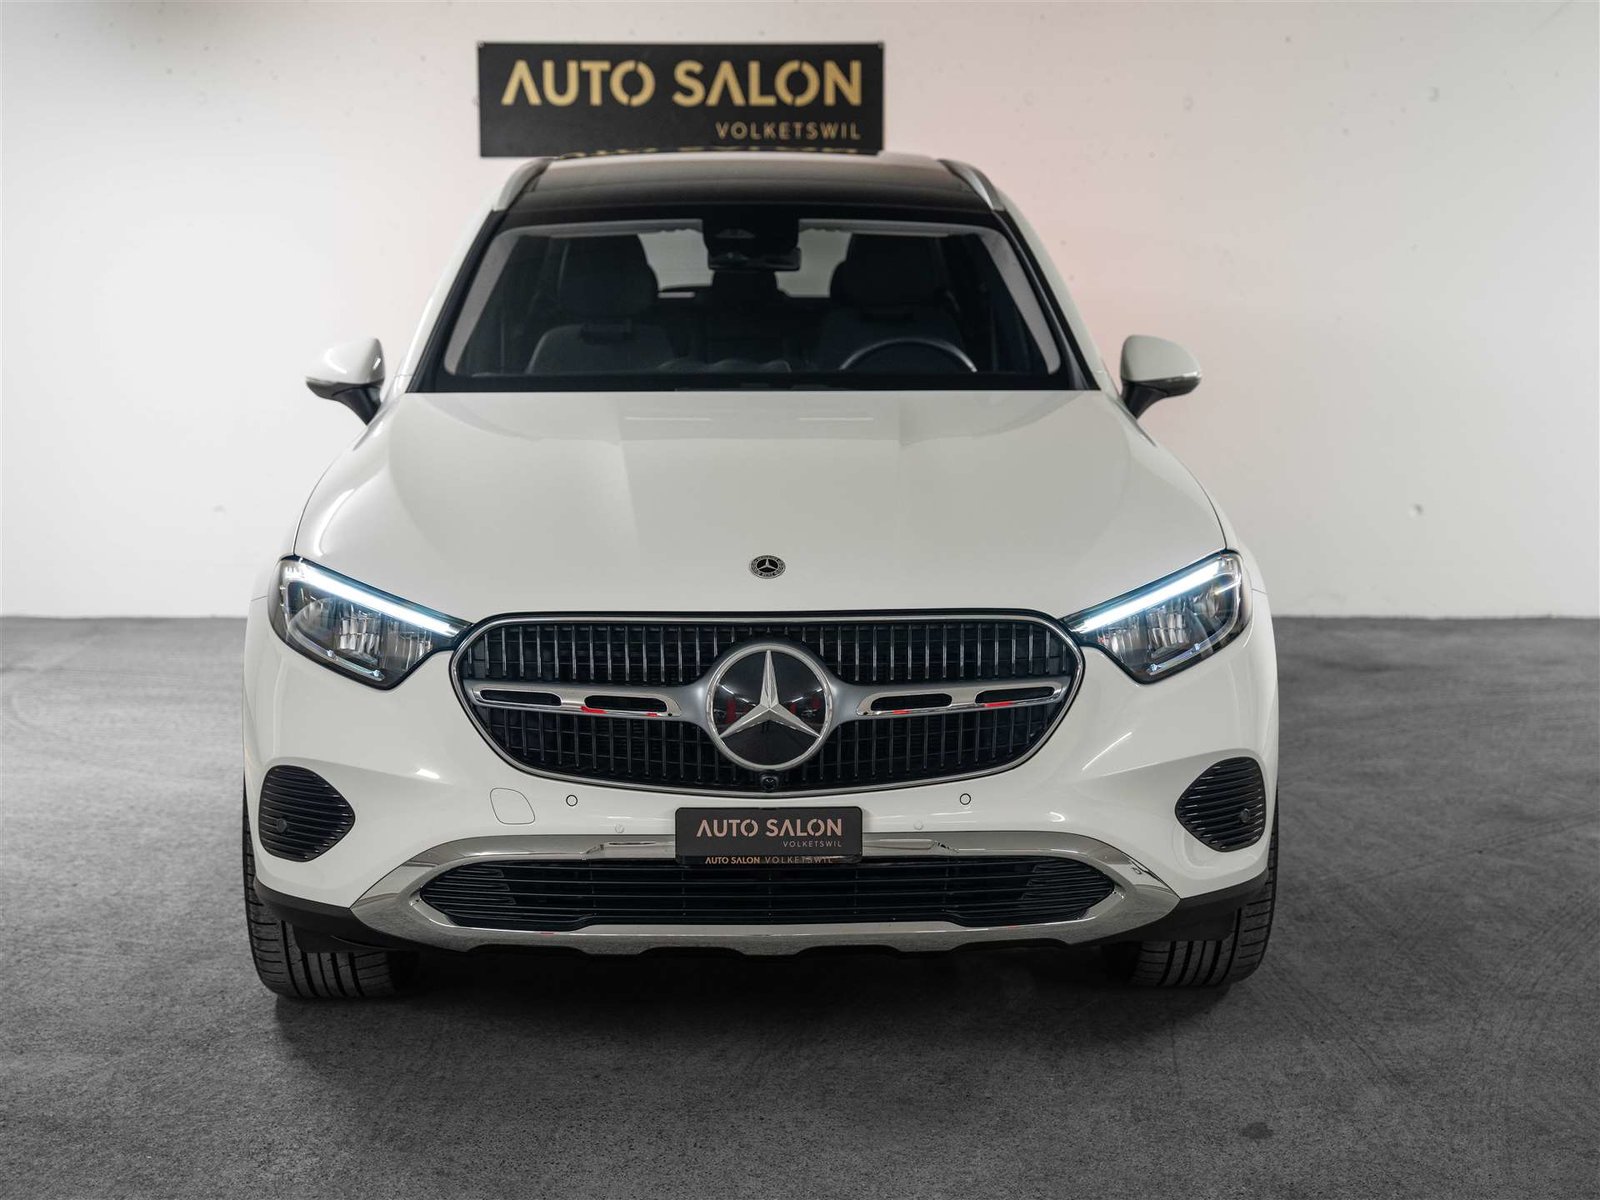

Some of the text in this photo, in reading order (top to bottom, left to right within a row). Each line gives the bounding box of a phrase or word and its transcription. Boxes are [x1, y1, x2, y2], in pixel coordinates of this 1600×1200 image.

[500, 59, 862, 107] AUTO SALON
[715, 121, 862, 141] VOLKETSWIL
[696, 818, 842, 837] AUTO SALON
[705, 856, 833, 864] AUTO SALON VOLKETSWIL
